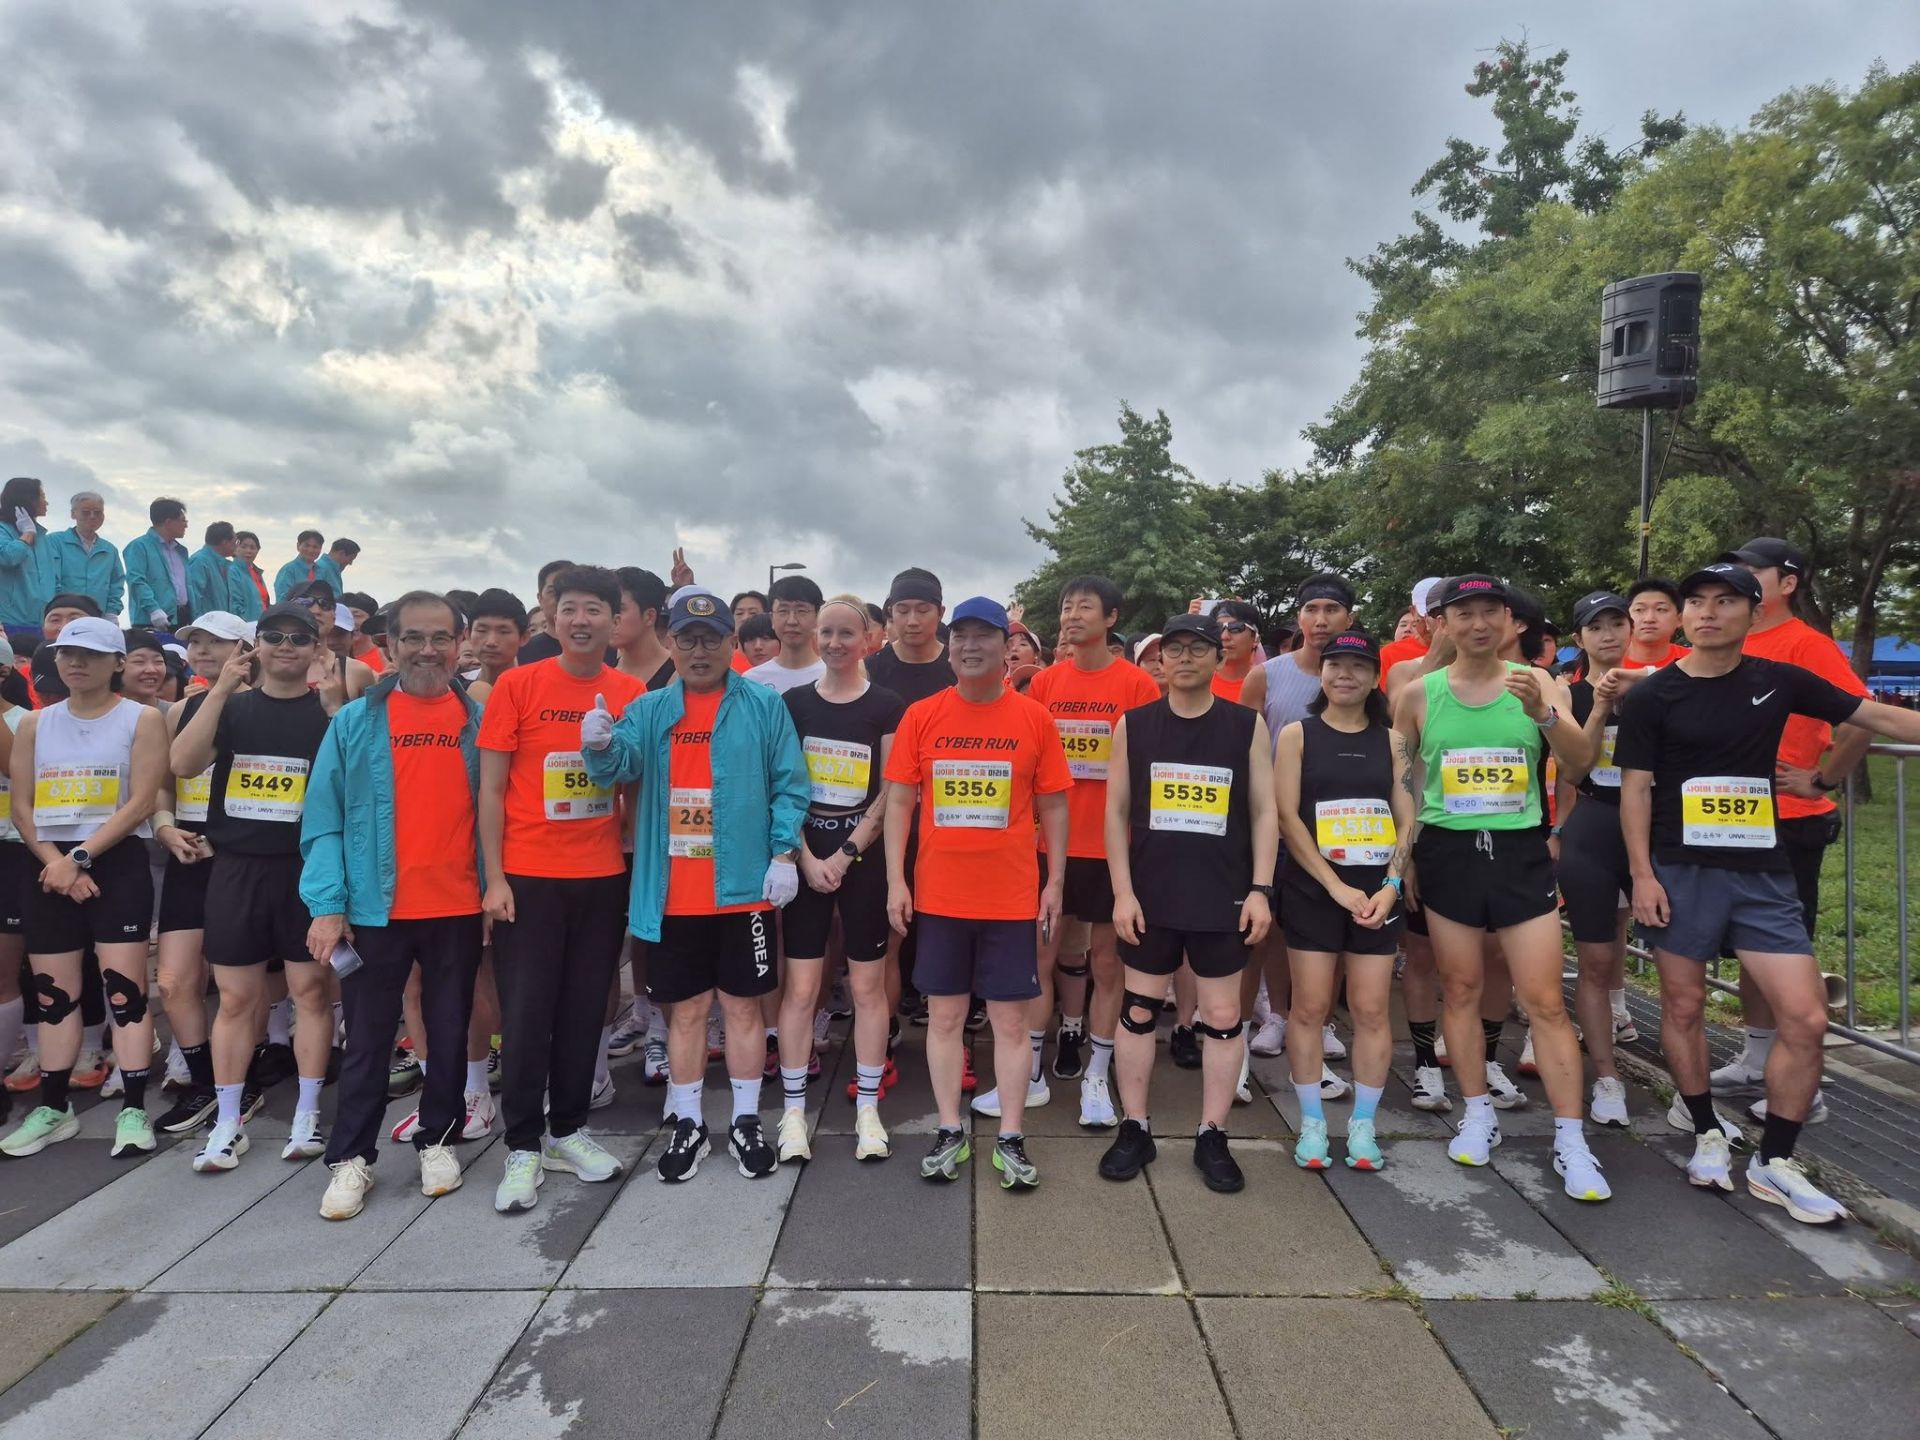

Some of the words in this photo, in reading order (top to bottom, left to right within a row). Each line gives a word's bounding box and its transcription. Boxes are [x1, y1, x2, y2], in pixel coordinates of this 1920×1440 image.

[1049, 702, 1088, 713] CYBER
[1089, 702, 1118, 714] RUN
[390, 733, 435, 748] YBER
[935, 736, 983, 749] CYBER
[985, 738, 1019, 751] RUN
[241, 774, 293, 792] 5449
[1457, 768, 1514, 784] 5652
[49, 780, 102, 797] 6733
[945, 781, 997, 797] 5356
[1163, 784, 1217, 803] 5535
[1701, 798, 1759, 815] 5587
[751, 911, 769, 978] KOREA
